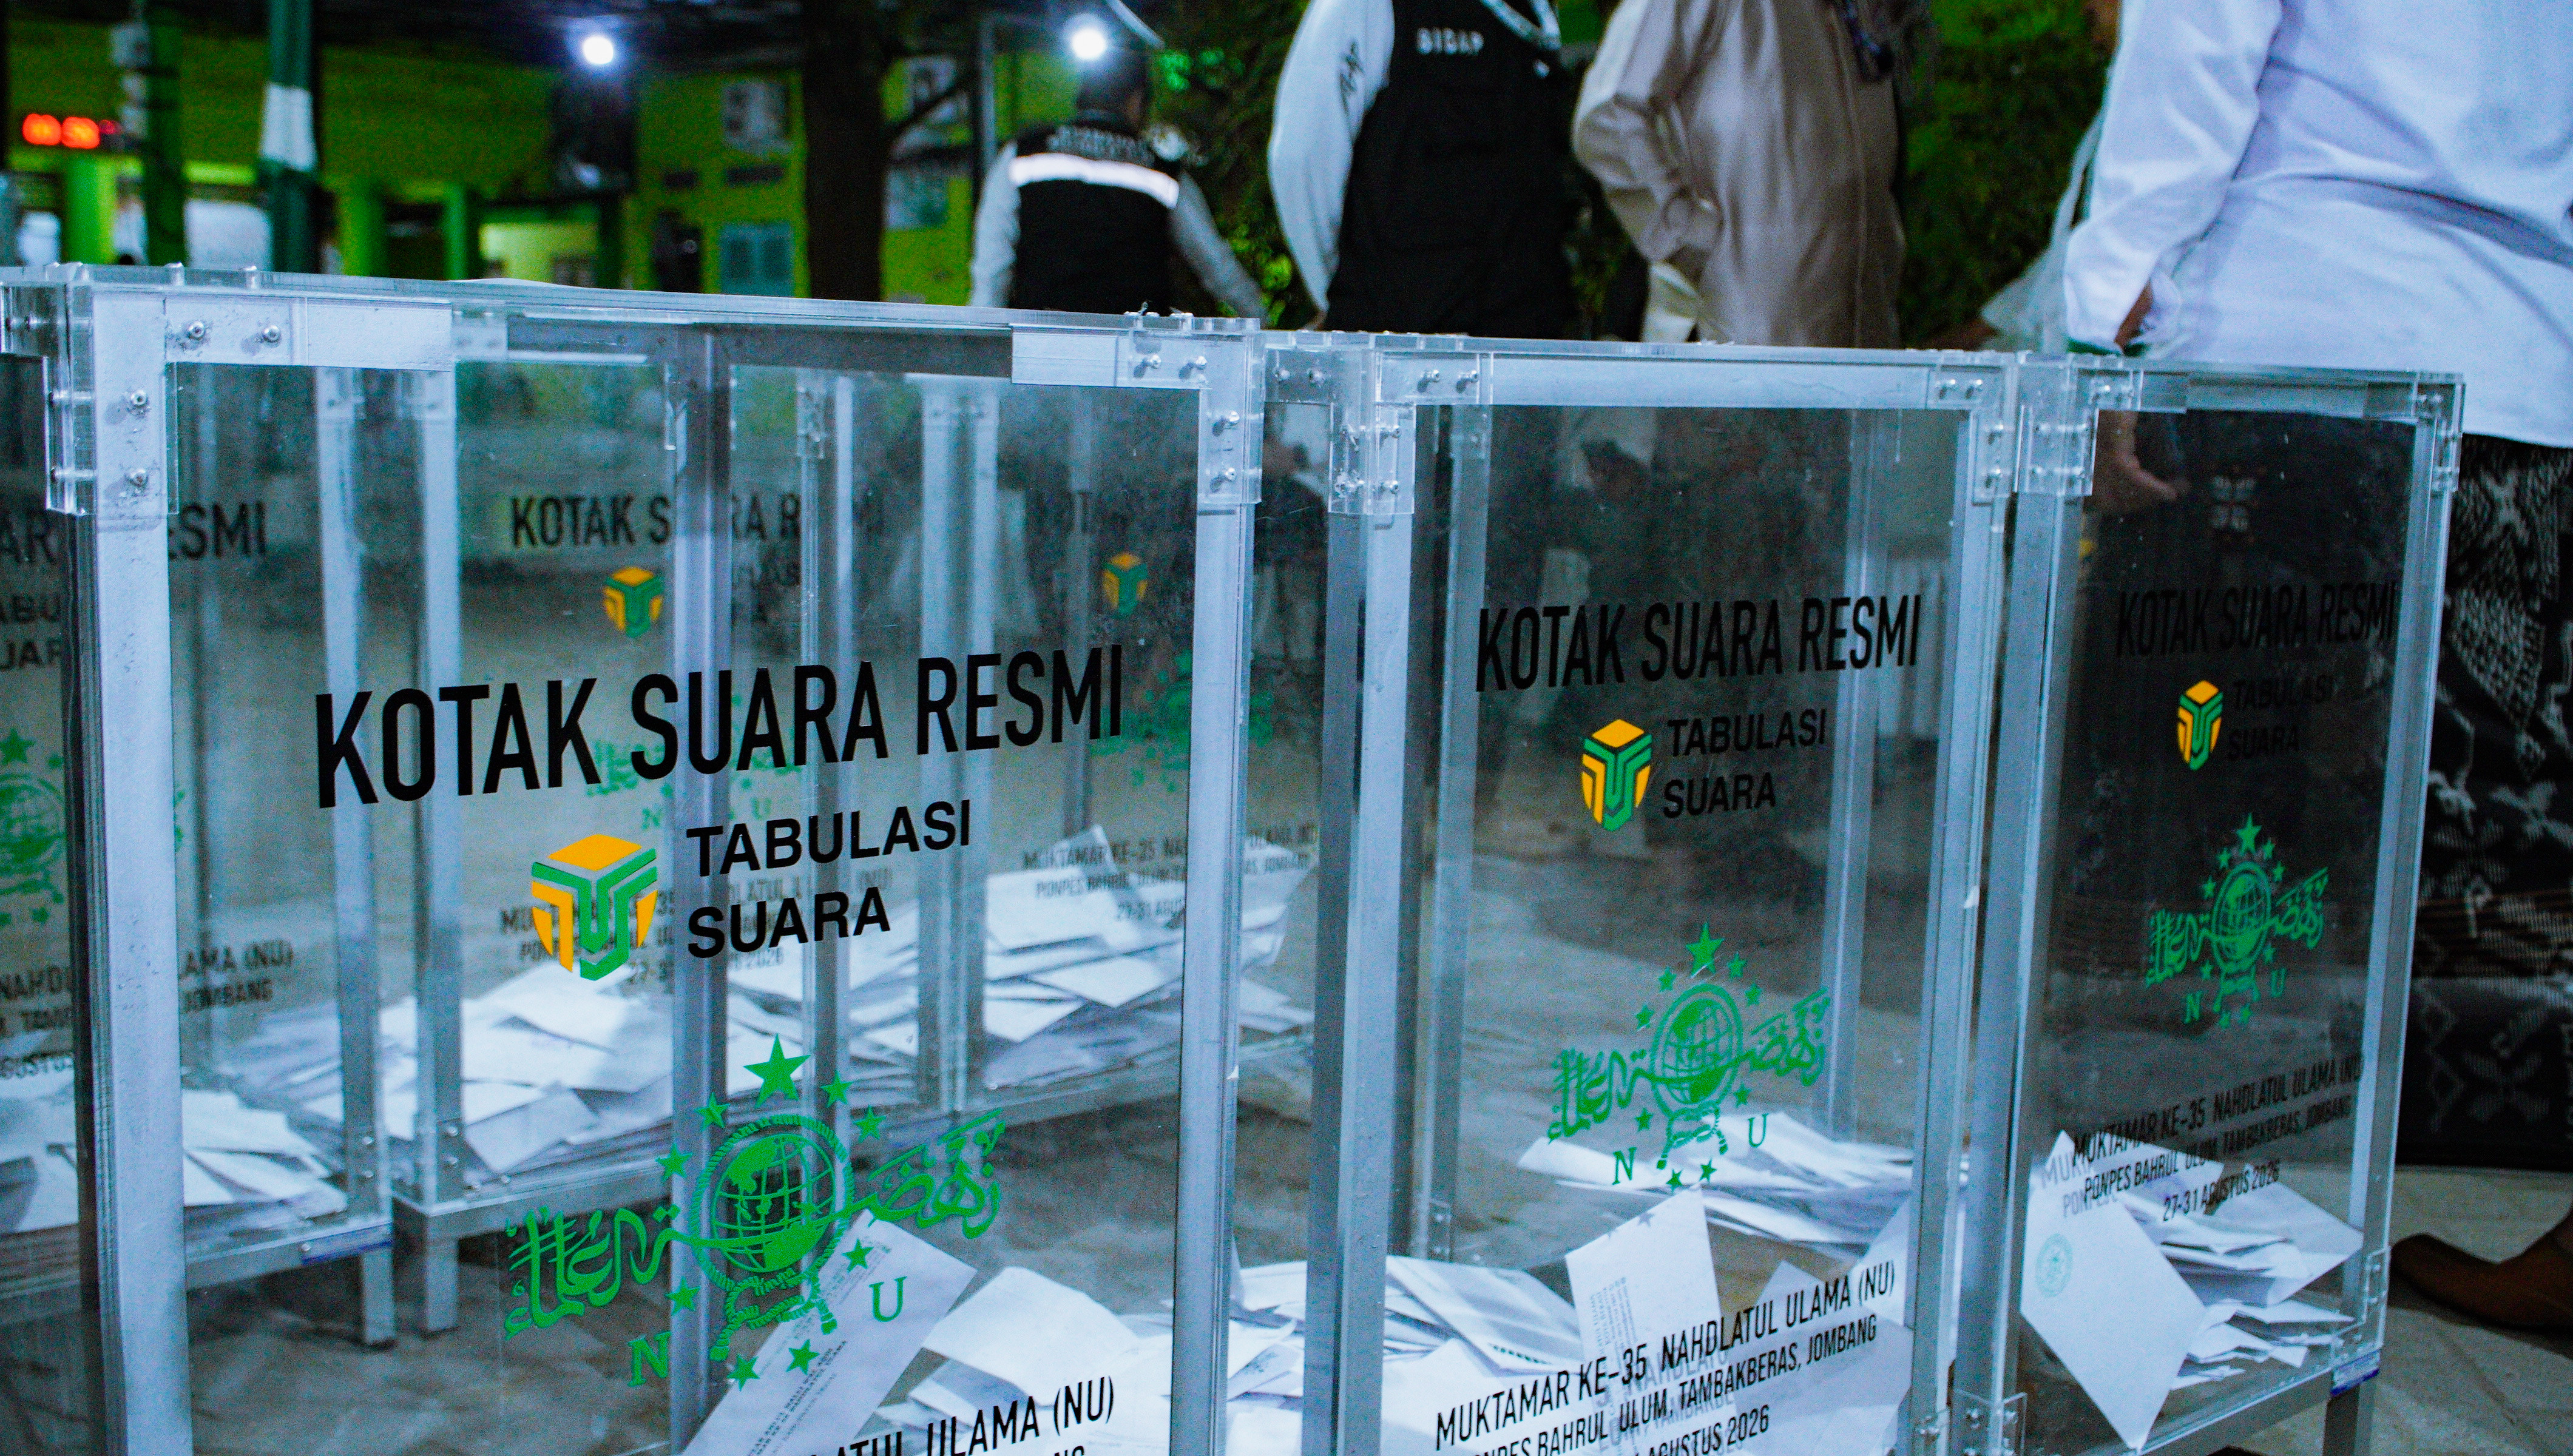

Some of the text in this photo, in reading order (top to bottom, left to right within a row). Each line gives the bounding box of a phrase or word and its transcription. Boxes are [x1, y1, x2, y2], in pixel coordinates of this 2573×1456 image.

[169, 499, 268, 561] SMI
[510, 493, 636, 548] KOTAK
[1476, 594, 1922, 692] KOTAK SUARA RESMI
[2117, 579, 2396, 658] KOTAK SUARA RESMI
[316, 678, 601, 808] KOTAK
[631, 661, 888, 780] SUARA
[916, 644, 1121, 755] RESMI
[1667, 709, 1827, 757] TABULASI
[1663, 772, 1776, 818] SUARA
[686, 799, 970, 877] TABULASI
[688, 886, 890, 959] SUARA
[2184, 968, 2287, 1023] N U
[1612, 1113, 1770, 1185] N U
[2072, 1111, 2158, 1167] MUKTAMAR
[2162, 1097, 2206, 1137] KE-35
[2083, 1163, 2131, 1205] PONPES
[2134, 1150, 2179, 1187] BAHRUL
[2162, 1187, 2199, 1222] 27-31
[2251, 1158, 2281, 1190] 2026
[628, 1276, 907, 1387] N U
[1435, 1370, 1569, 1452] MUKTAMAR
[1578, 1343, 1648, 1401] KE-35
[1661, 1300, 1778, 1372] NAHDLATUL
[1786, 1273, 1851, 1328] ULAMA
[1859, 1259, 1895, 1307] (NU)
[926, 1396, 1040, 1456] ULAMA
[1053, 1376, 1114, 1437] (NU)
[1538, 1410, 1609, 1456] BAHRUL
[1679, 1342, 1802, 1410] TAMBAKBERAS,
[1806, 1313, 1878, 1366] JOMBANG
[1726, 1404, 1770, 1446] 2026
